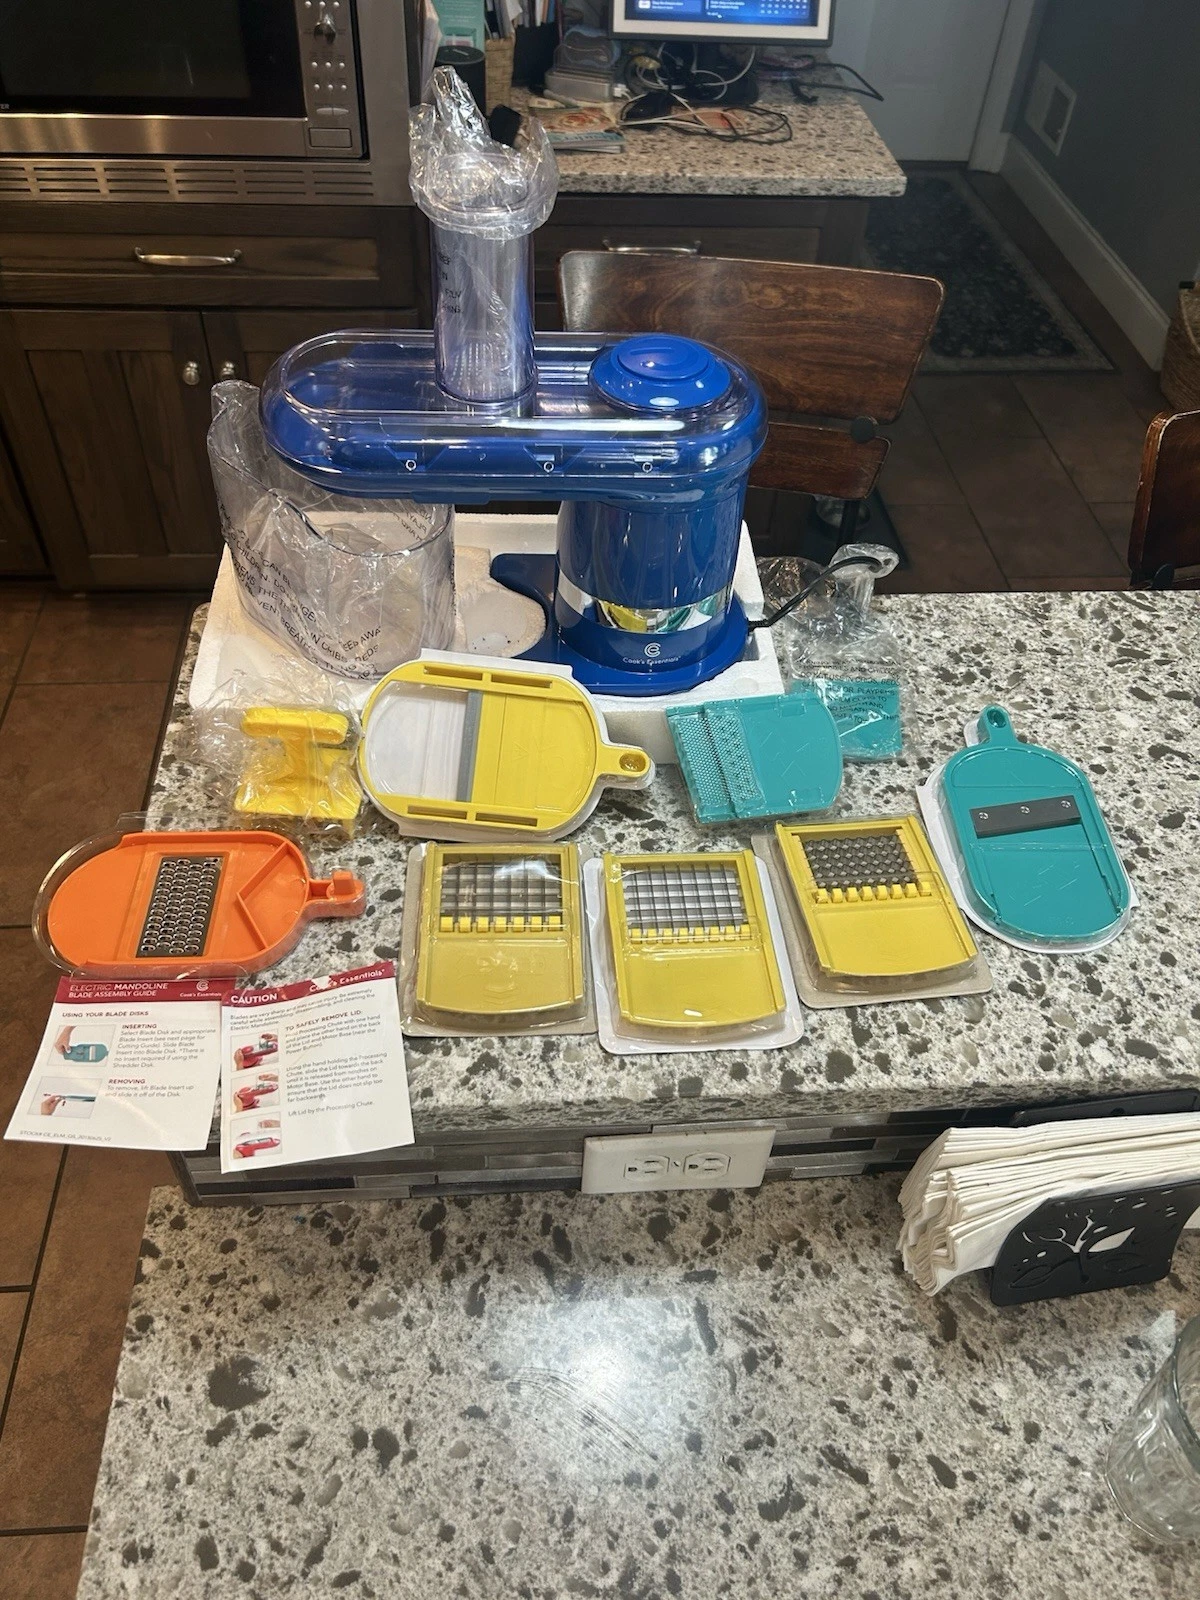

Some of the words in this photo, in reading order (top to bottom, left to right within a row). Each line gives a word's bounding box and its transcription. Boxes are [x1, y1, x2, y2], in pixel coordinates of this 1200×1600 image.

[230, 993, 278, 1004] CAUTION
[340, 970, 383, 984] Essentials
[296, 1019, 319, 1028] SAFELY
[321, 1012, 348, 1022] REMOVE
